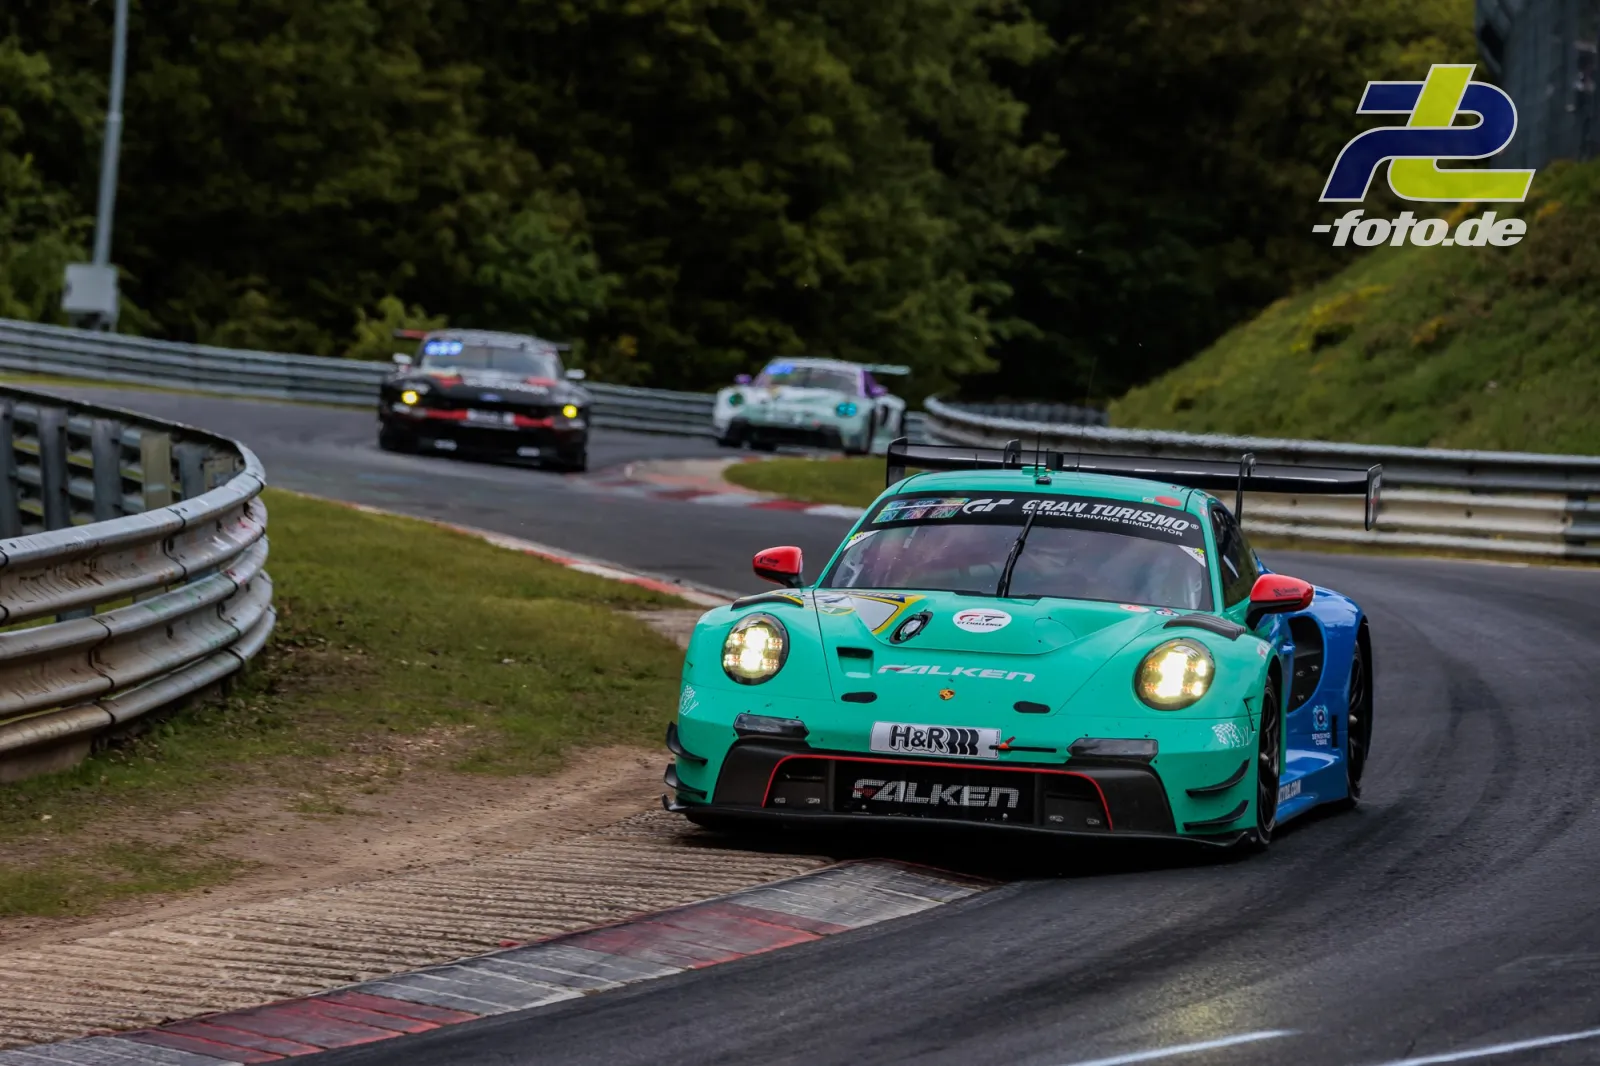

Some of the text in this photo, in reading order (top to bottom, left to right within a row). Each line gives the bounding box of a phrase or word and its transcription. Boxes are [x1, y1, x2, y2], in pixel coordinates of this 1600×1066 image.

[1022, 499, 1088, 513] GRAN
[1076, 513, 1119, 522] DRIVING
[1122, 519, 1183, 536] SIMULATOR
[877, 664, 1036, 682] FALKEN
[889, 725, 947, 753] H&R
[852, 778, 1019, 808] FALKEN
